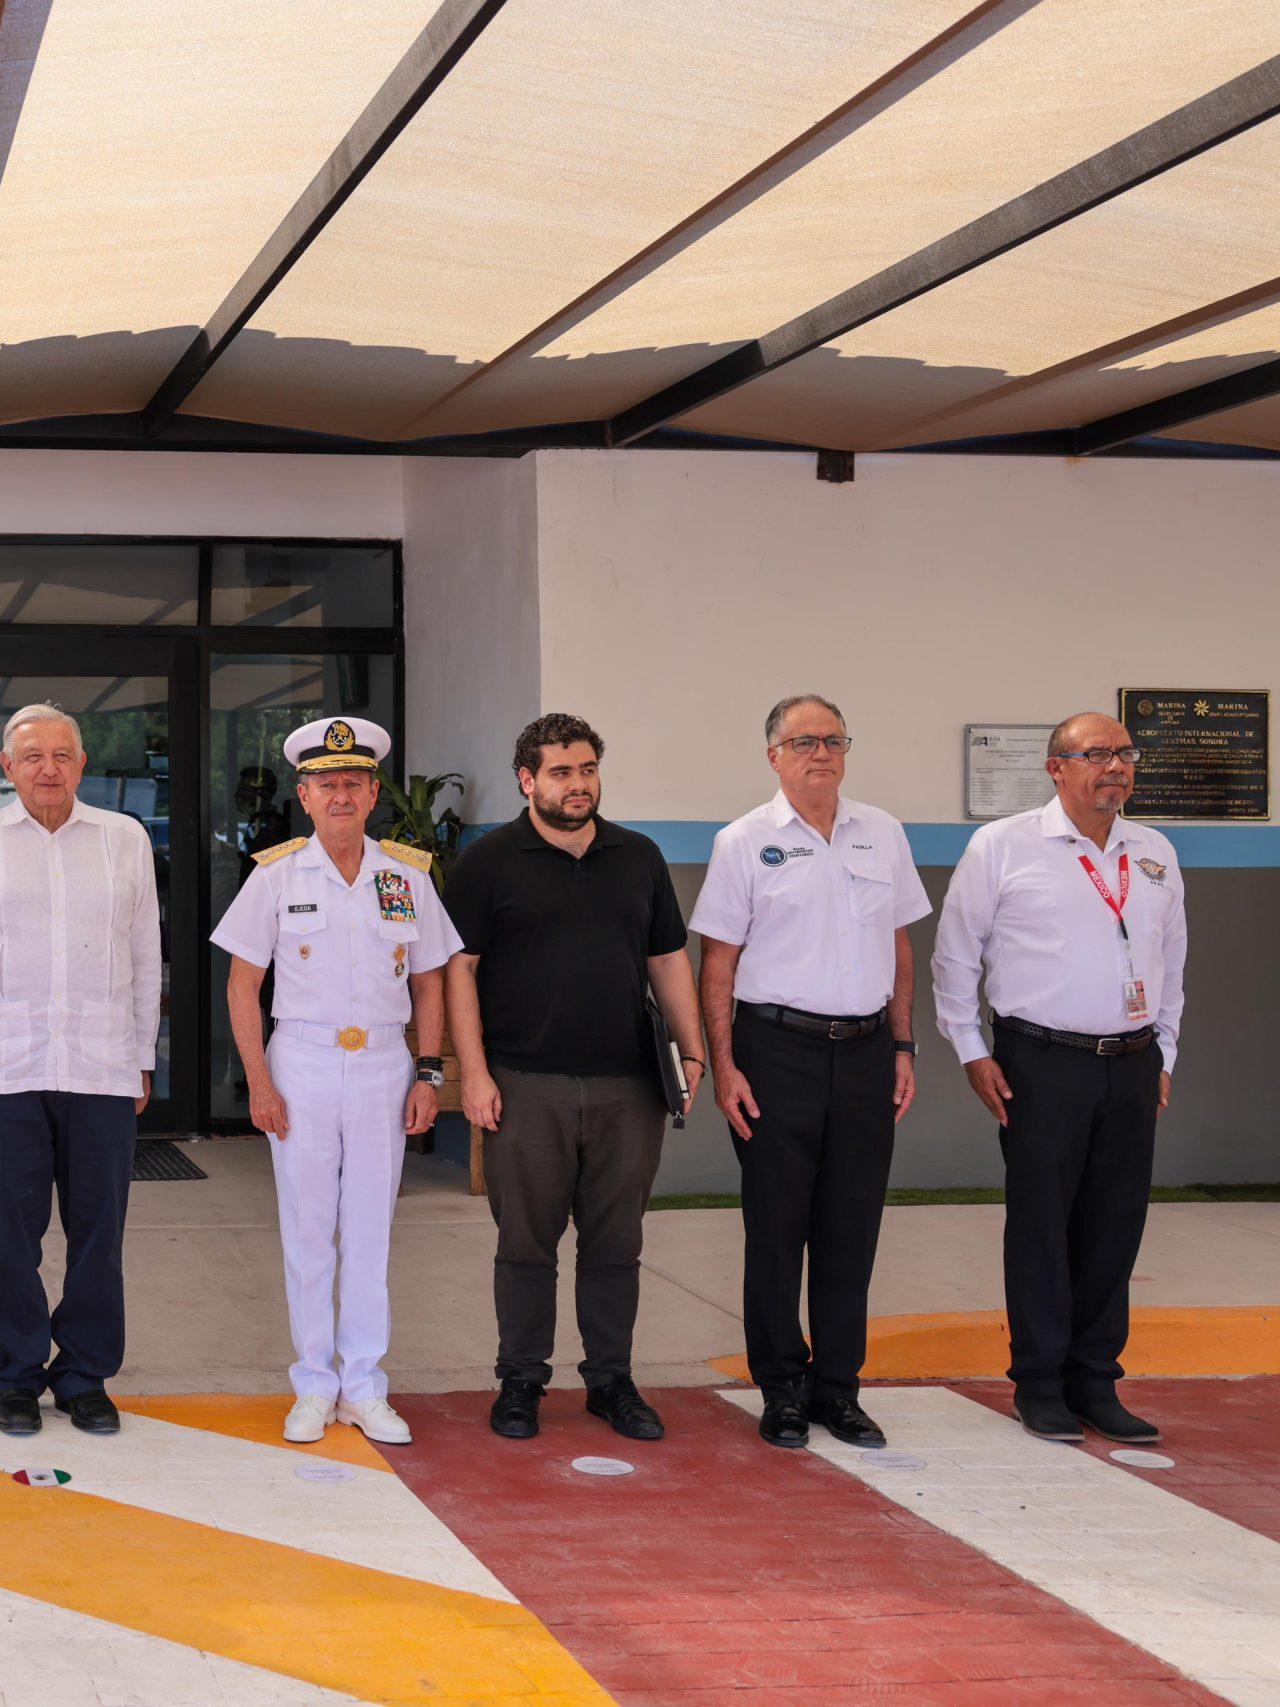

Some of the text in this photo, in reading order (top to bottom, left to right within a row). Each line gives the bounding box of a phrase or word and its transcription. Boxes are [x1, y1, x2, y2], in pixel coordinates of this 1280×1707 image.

[1184, 730, 1241, 738] INTERNACIONAL
[1089, 870, 1111, 899] MEXICO
[1120, 870, 1128, 898] MEXICO
